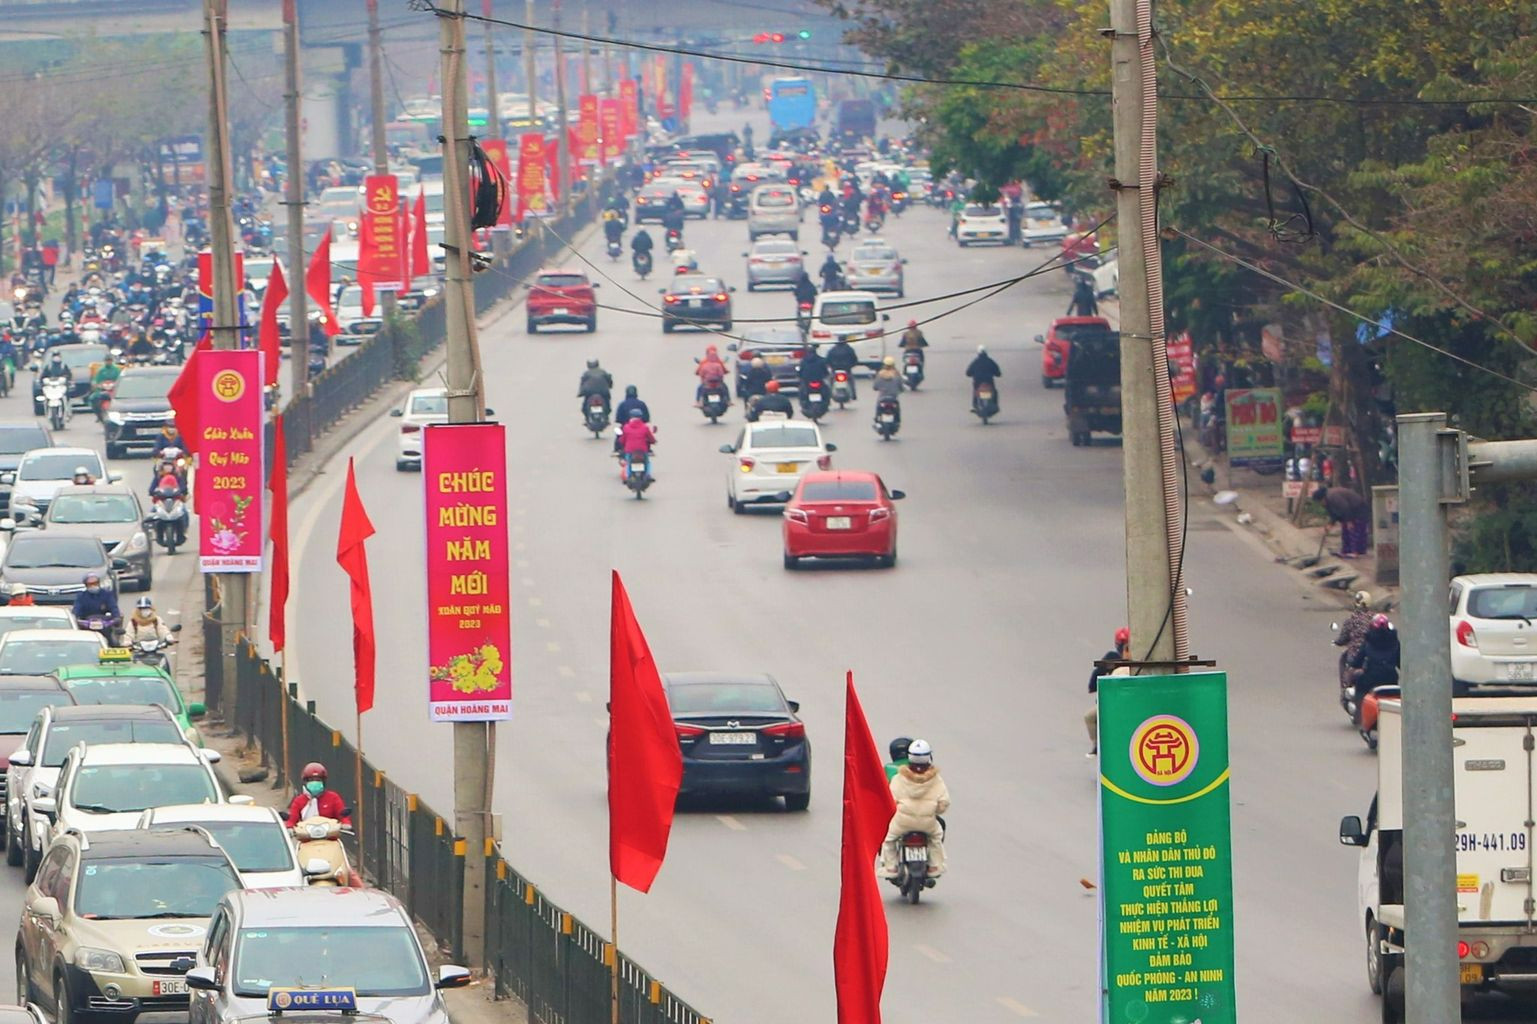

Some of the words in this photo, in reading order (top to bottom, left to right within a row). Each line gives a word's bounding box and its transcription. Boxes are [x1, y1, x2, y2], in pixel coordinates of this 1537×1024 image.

[213, 476, 246, 489] 2023
[439, 467, 494, 492] CHÚC
[439, 502, 496, 527] MỪNG
[446, 536, 490, 561] NĂM
[451, 570, 488, 595] MỚI
[459, 619, 481, 629] 2023
[435, 705, 458, 716] QUẬN
[461, 704, 489, 714] HOÀNG
[492, 705, 508, 713] MAI
[1146, 829, 1172, 845] ĐẢNG
[1174, 829, 1187, 846] BỘ
[1455, 832, 1526, 852] 29H-441.09
[1119, 849, 1131, 863] VÀ
[1133, 848, 1159, 863] NHÂN
[1162, 847, 1181, 861] DÂN
[1183, 844, 1201, 860] THỦ
[1203, 845, 1216, 859] ĐÔ
[1133, 868, 1145, 880] RA
[1147, 865, 1166, 880] SỨC
[1168, 866, 1183, 878] THI
[1185, 866, 1203, 878] ĐUA
[1143, 881, 1171, 898] QUYẾT
[1174, 881, 1194, 896] TÂM
[1120, 903, 1144, 918] THỰC
[1146, 900, 1168, 917] HIỆN
[1170, 897, 1201, 913] THẮNG
[1203, 899, 1218, 914] LỢI
[1120, 919, 1150, 935] NHIỆM
[1152, 920, 1165, 934] VỤ
[1167, 917, 1191, 931] PHÁT
[1192, 914, 1219, 930] TRIỂN
[1133, 938, 1155, 950] KINH
[1157, 933, 1168, 949] TẾ
[1177, 934, 1189, 948] XÃ
[1192, 933, 1208, 950] HỘI
[1149, 951, 1171, 967] ĐẢM
[1173, 950, 1192, 966] BẢO
[1116, 969, 1142, 987] QUỐC
[1144, 969, 1175, 985] PHÒNG
[1184, 970, 1198, 983] AN
[1200, 969, 1223, 982] NINH
[161, 982, 189, 993] 30E-0
[1145, 988, 1167, 1002] NĂM
[1170, 989, 1192, 1001] 2023
